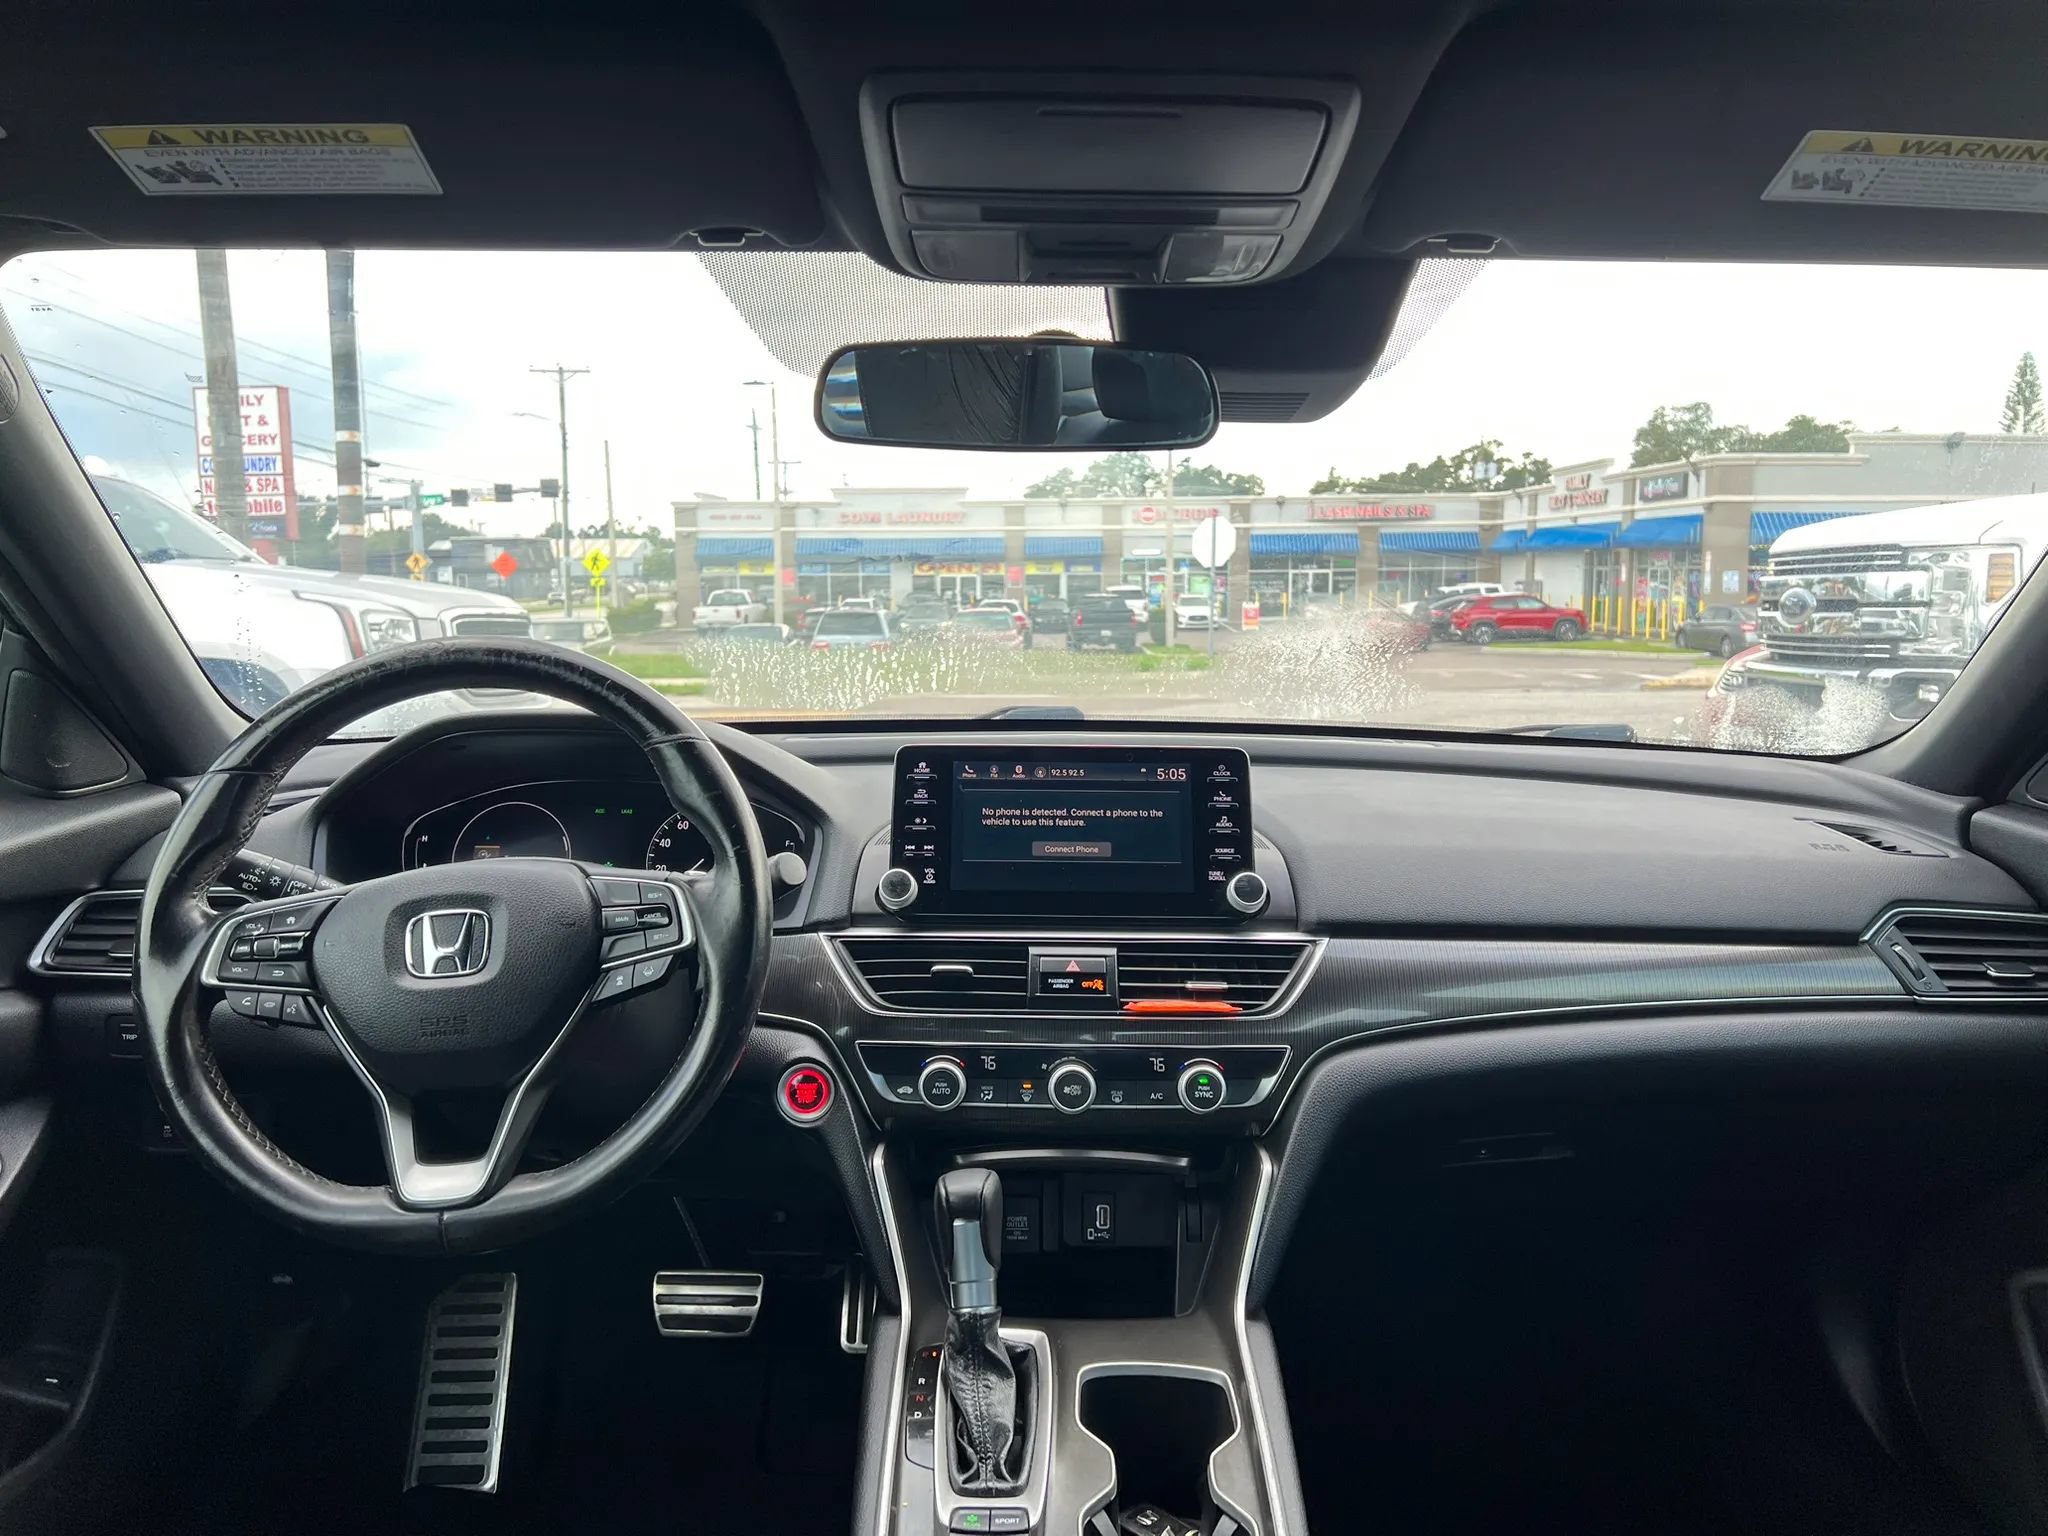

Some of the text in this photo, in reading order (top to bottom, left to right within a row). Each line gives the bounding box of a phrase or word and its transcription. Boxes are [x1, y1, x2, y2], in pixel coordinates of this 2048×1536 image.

[193, 129, 369, 144] WARNING
[1899, 138, 2048, 162] WARNIN
[240, 394, 264, 406] ILY
[256, 478, 280, 493] SPA
[1051, 769, 1067, 777] 92.5
[1068, 769, 1085, 777] 92.5
[1157, 768, 1186, 780] 5:05
[982, 808, 994, 816] No
[996, 808, 1021, 818] phone
[1022, 808, 1030, 816] is
[1031, 808, 1069, 816] detected.
[1071, 808, 1104, 817] Connect
[1113, 809, 1138, 819] phone
[1150, 809, 1163, 817] the
[677, 821, 689, 830] 60
[982, 818, 1011, 826] vehicle
[1012, 818, 1020, 826] to
[1038, 818, 1053, 826] this
[1055, 818, 1087, 826] feature.
[659, 838, 671, 848] 40
[1045, 845, 1099, 854] Connect Phone
[655, 864, 667, 872] 20
[238, 873, 258, 882] AUTO
[293, 880, 307, 889] OFF
[122, 1033, 138, 1041] TRIP
[981, 1056, 996, 1070] 76
[1149, 1058, 1165, 1072] 76
[931, 1087, 951, 1095] AUTO
[918, 1377, 926, 1385] R
[915, 1394, 924, 1402] N
[914, 1411, 922, 1419] D
[995, 1517, 1020, 1525] SPORT
